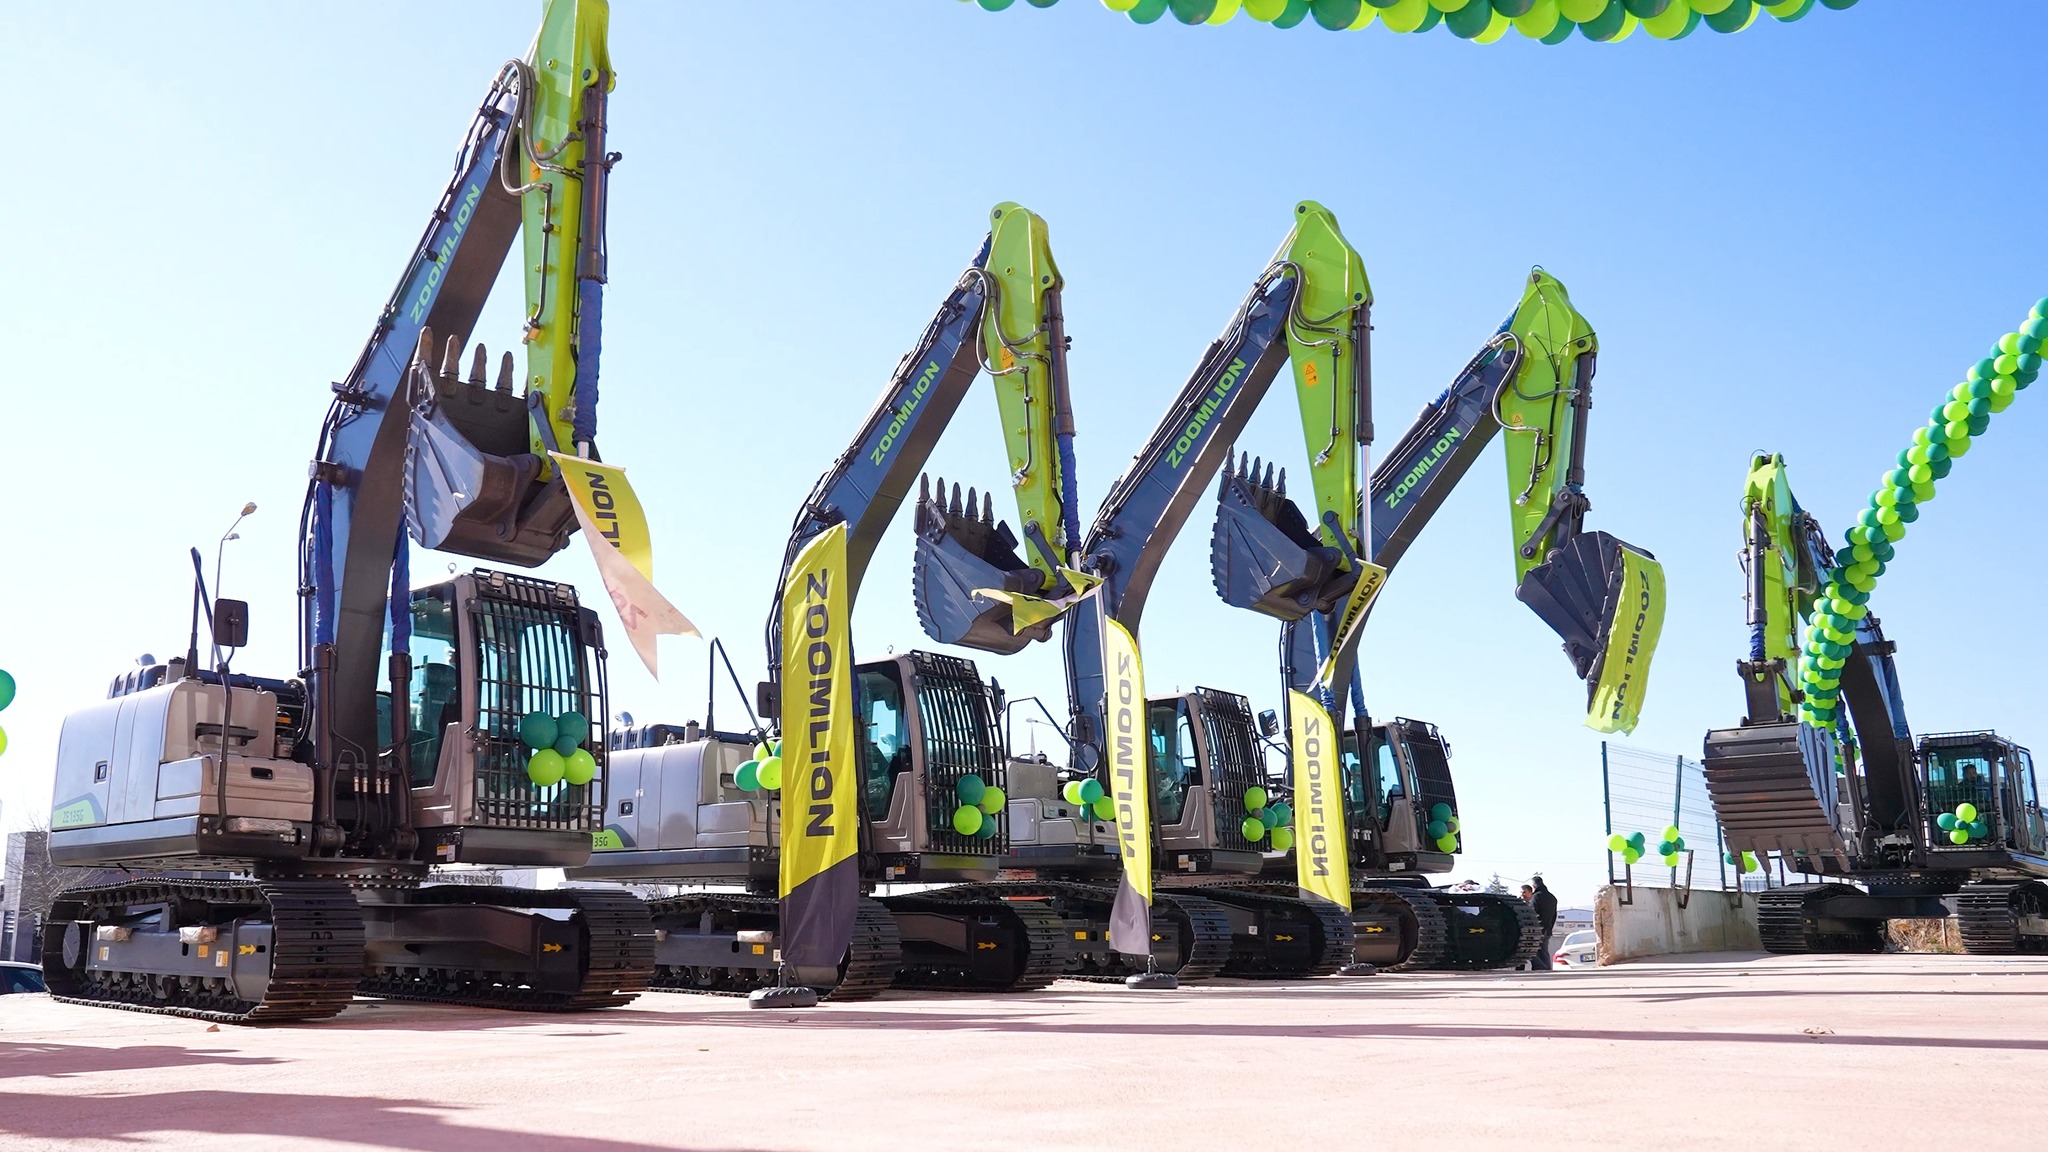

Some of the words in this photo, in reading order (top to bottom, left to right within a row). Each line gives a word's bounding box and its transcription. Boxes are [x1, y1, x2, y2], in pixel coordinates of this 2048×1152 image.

[410, 184, 480, 325] ZOOMLION
[870, 360, 940, 466] ZOOMLION
[1165, 357, 1247, 469] ZOOMLION
[1384, 427, 1461, 509] ZOOMLION
[1611, 570, 1650, 720] ZOOMLION
[806, 568, 835, 837] ZOOMLION
[62, 808, 84, 823] ZE135G
[594, 836, 608, 847] 35G
